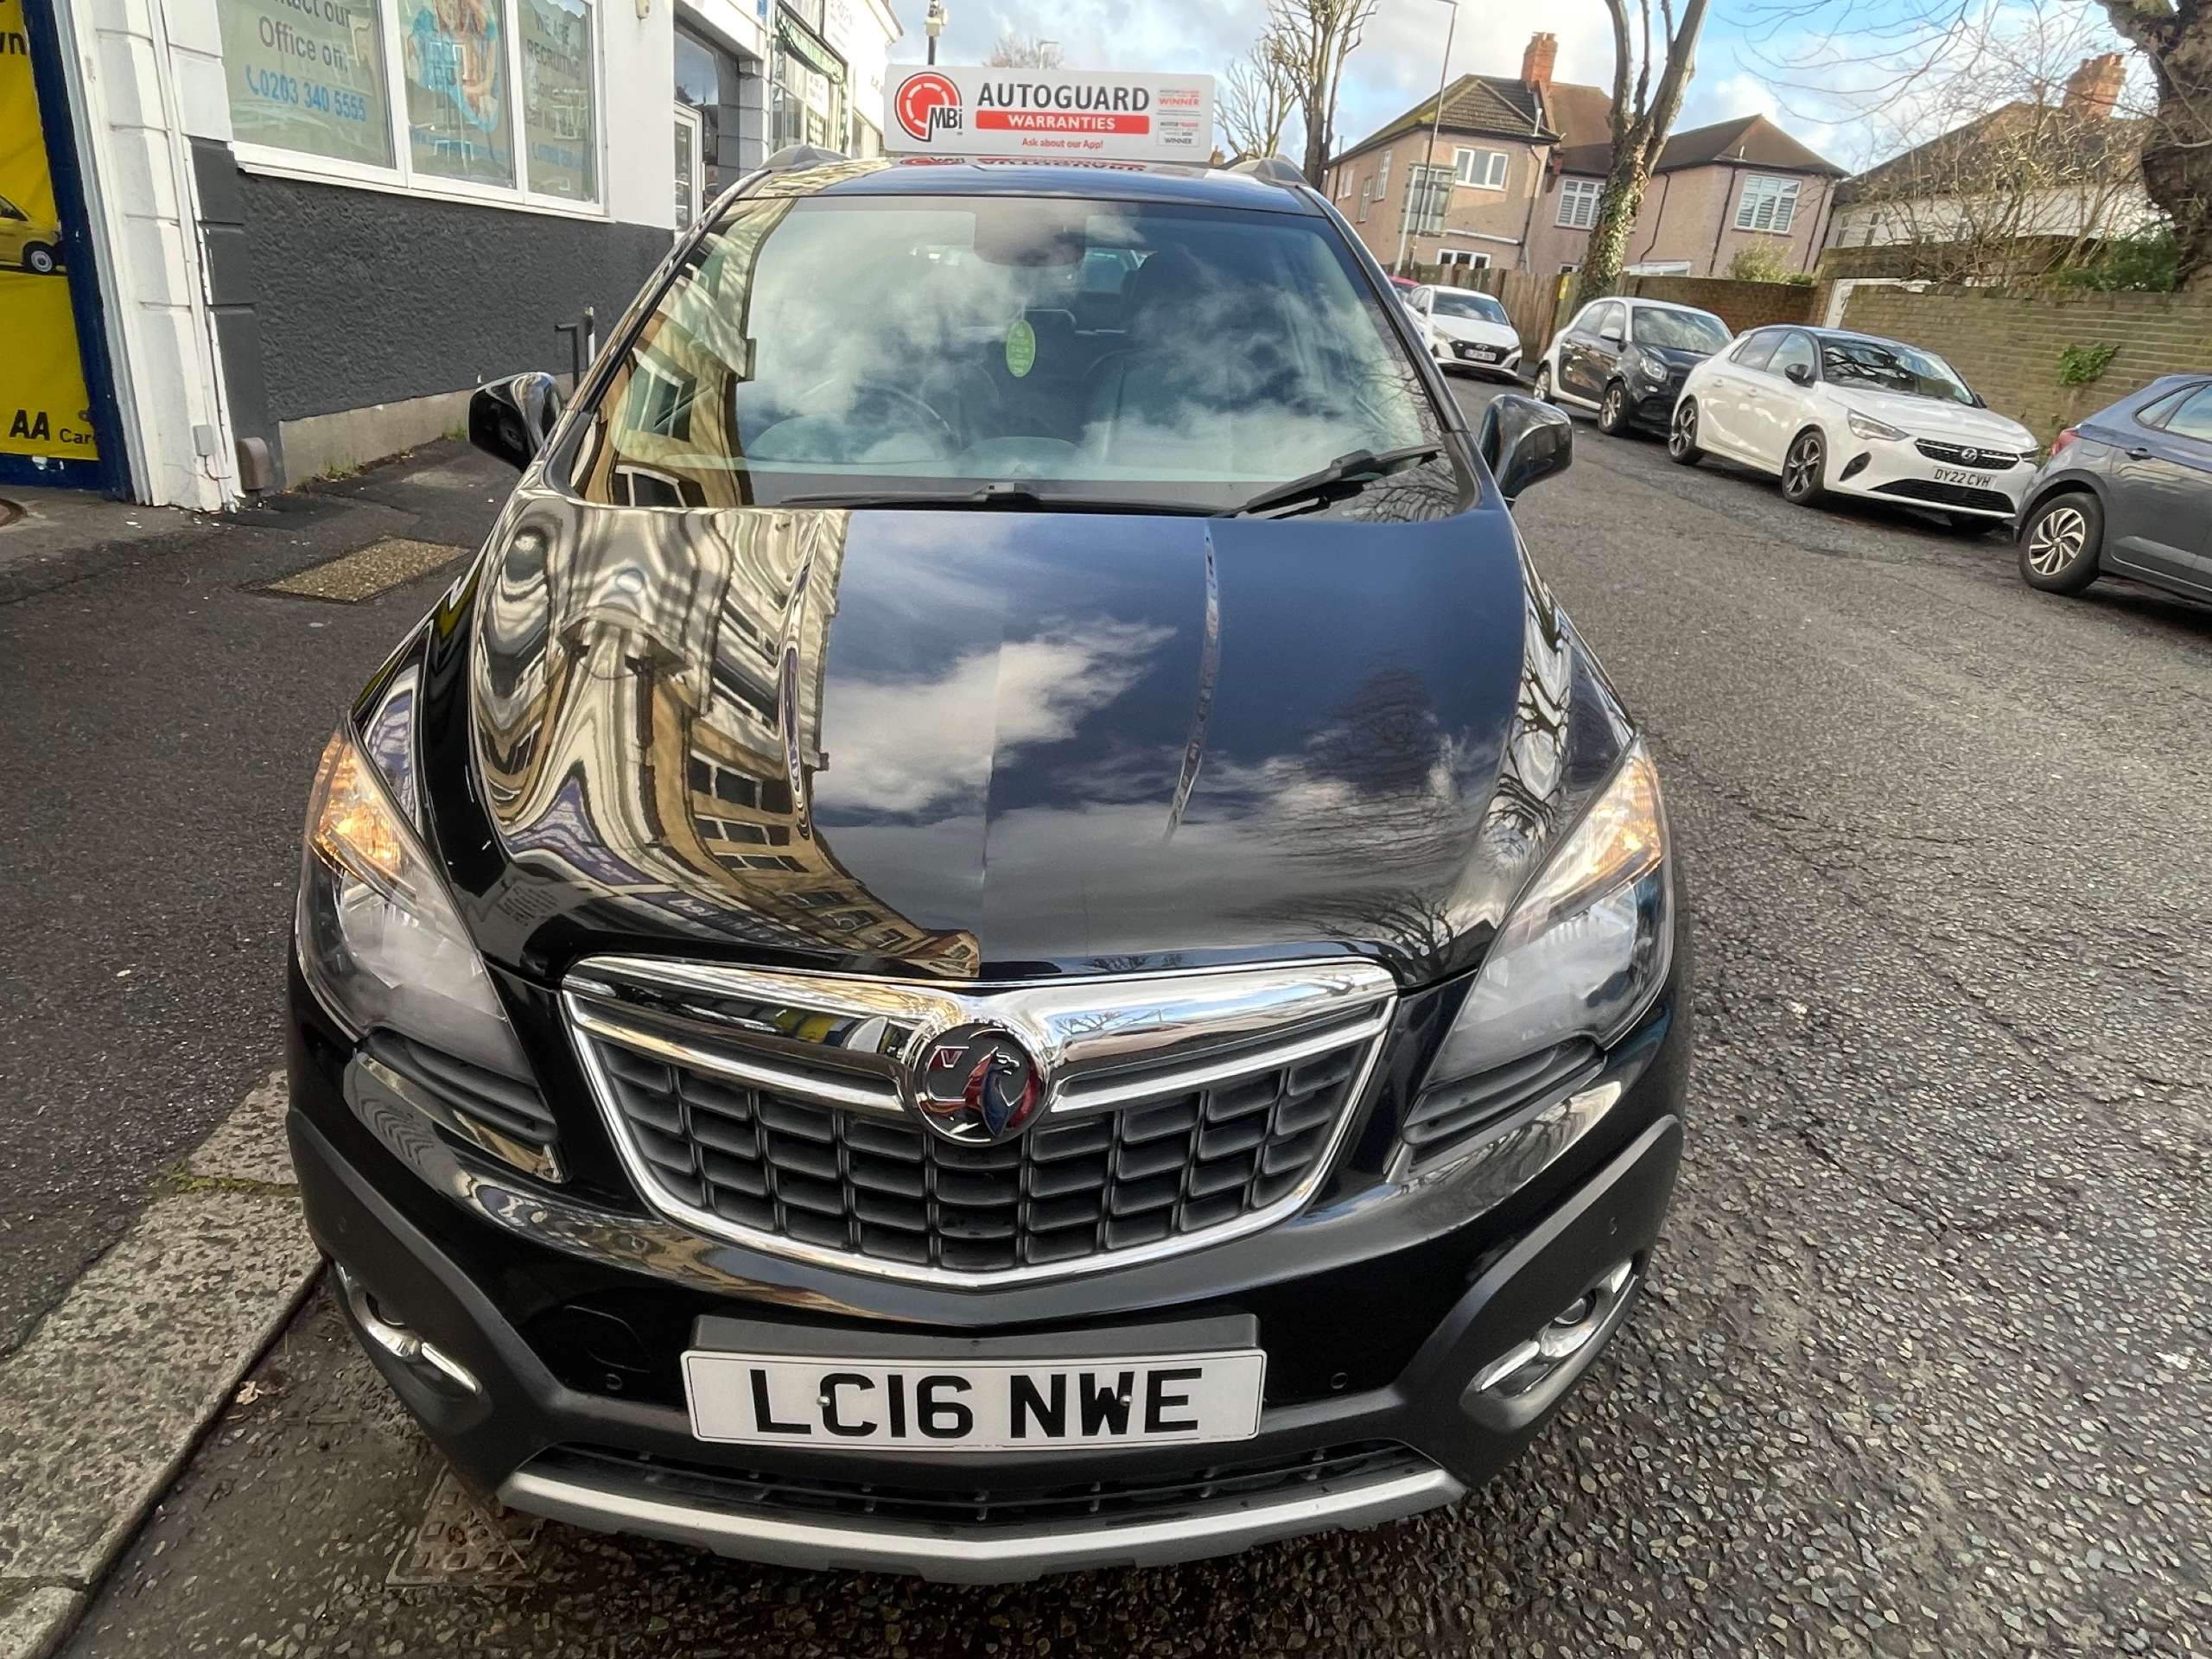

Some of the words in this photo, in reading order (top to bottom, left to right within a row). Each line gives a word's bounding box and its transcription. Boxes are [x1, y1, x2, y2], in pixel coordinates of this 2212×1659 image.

[324, 1, 351, 29] our
[259, 16, 316, 61] Office
[260, 69, 299, 105] 0203
[303, 82, 330, 113] 340
[334, 91, 367, 122] 5555
[977, 82, 1150, 111] AUTOGUARD
[1159, 97, 1200, 107] WINNER
[1007, 114, 1116, 130] WARRANTIES
[1022, 137, 1038, 147] Ask
[1039, 139, 1065, 148] about
[1083, 139, 1104, 152] App!
[9, 409, 50, 441] AA
[1934, 468, 1967, 484] DY22
[749, 1369, 975, 1439] LC16
[1009, 1367, 1203, 1439] NWE
